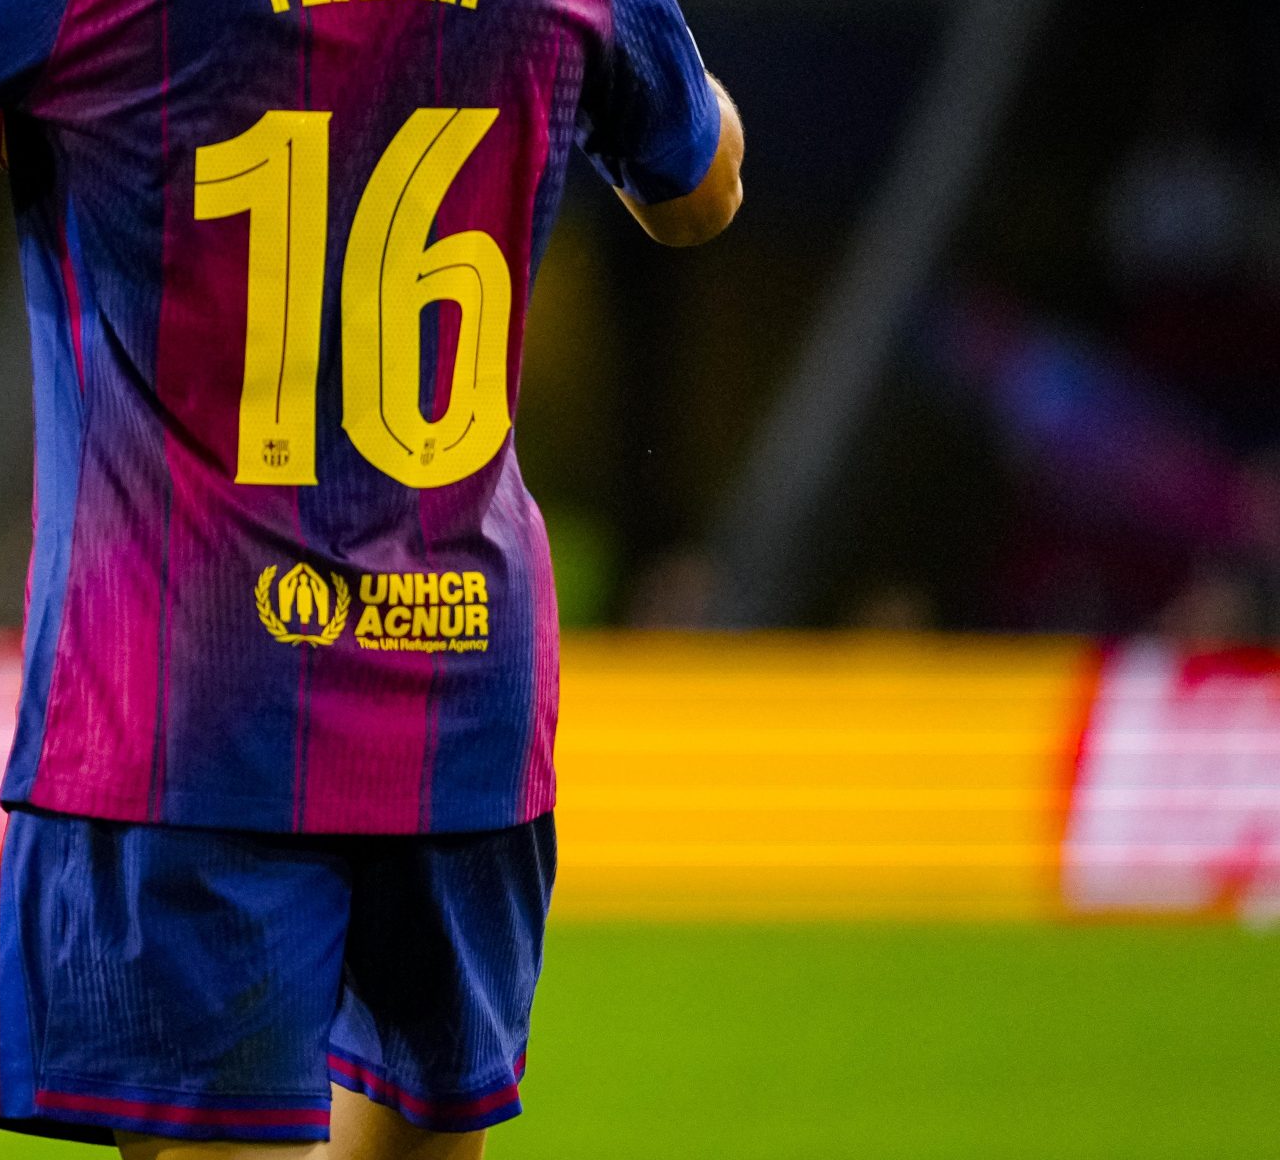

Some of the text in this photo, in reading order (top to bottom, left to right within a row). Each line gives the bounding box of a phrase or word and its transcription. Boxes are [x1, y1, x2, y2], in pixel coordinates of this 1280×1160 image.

[194, 107, 513, 489] 16
[359, 571, 488, 606] UNHCR
[354, 604, 489, 637] ACNUR
[356, 637, 489, 653] The UN Refugee Agency
